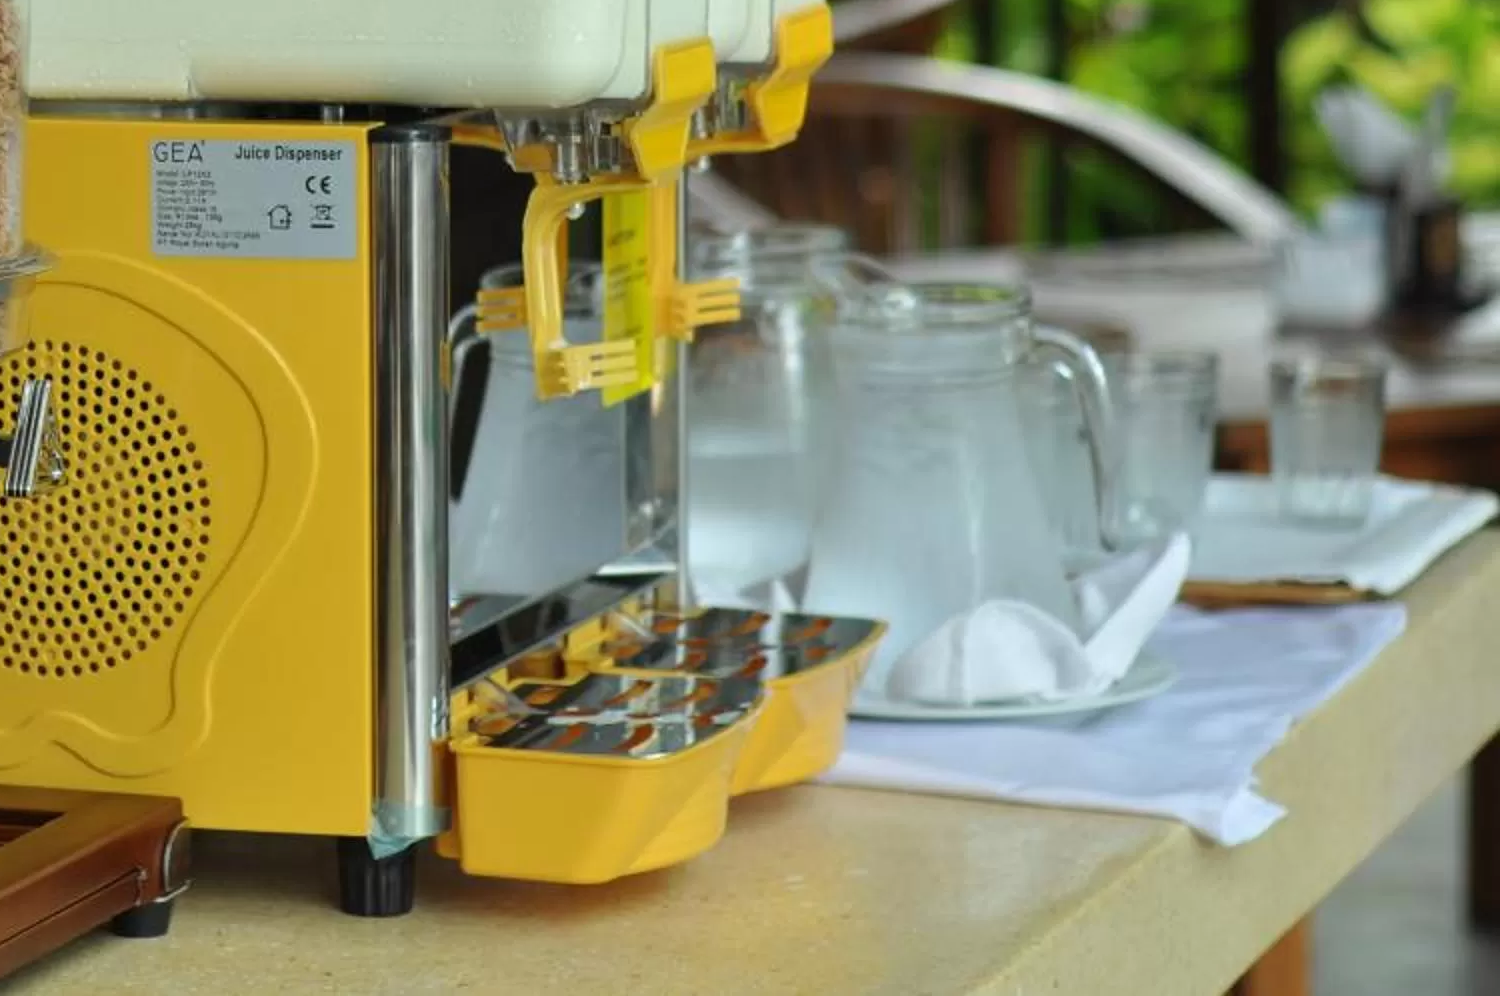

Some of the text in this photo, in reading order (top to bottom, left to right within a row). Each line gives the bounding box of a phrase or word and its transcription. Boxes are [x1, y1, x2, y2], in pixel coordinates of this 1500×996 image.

[154, 142, 203, 163] GEA
[235, 146, 343, 163] Juice Dispenser
